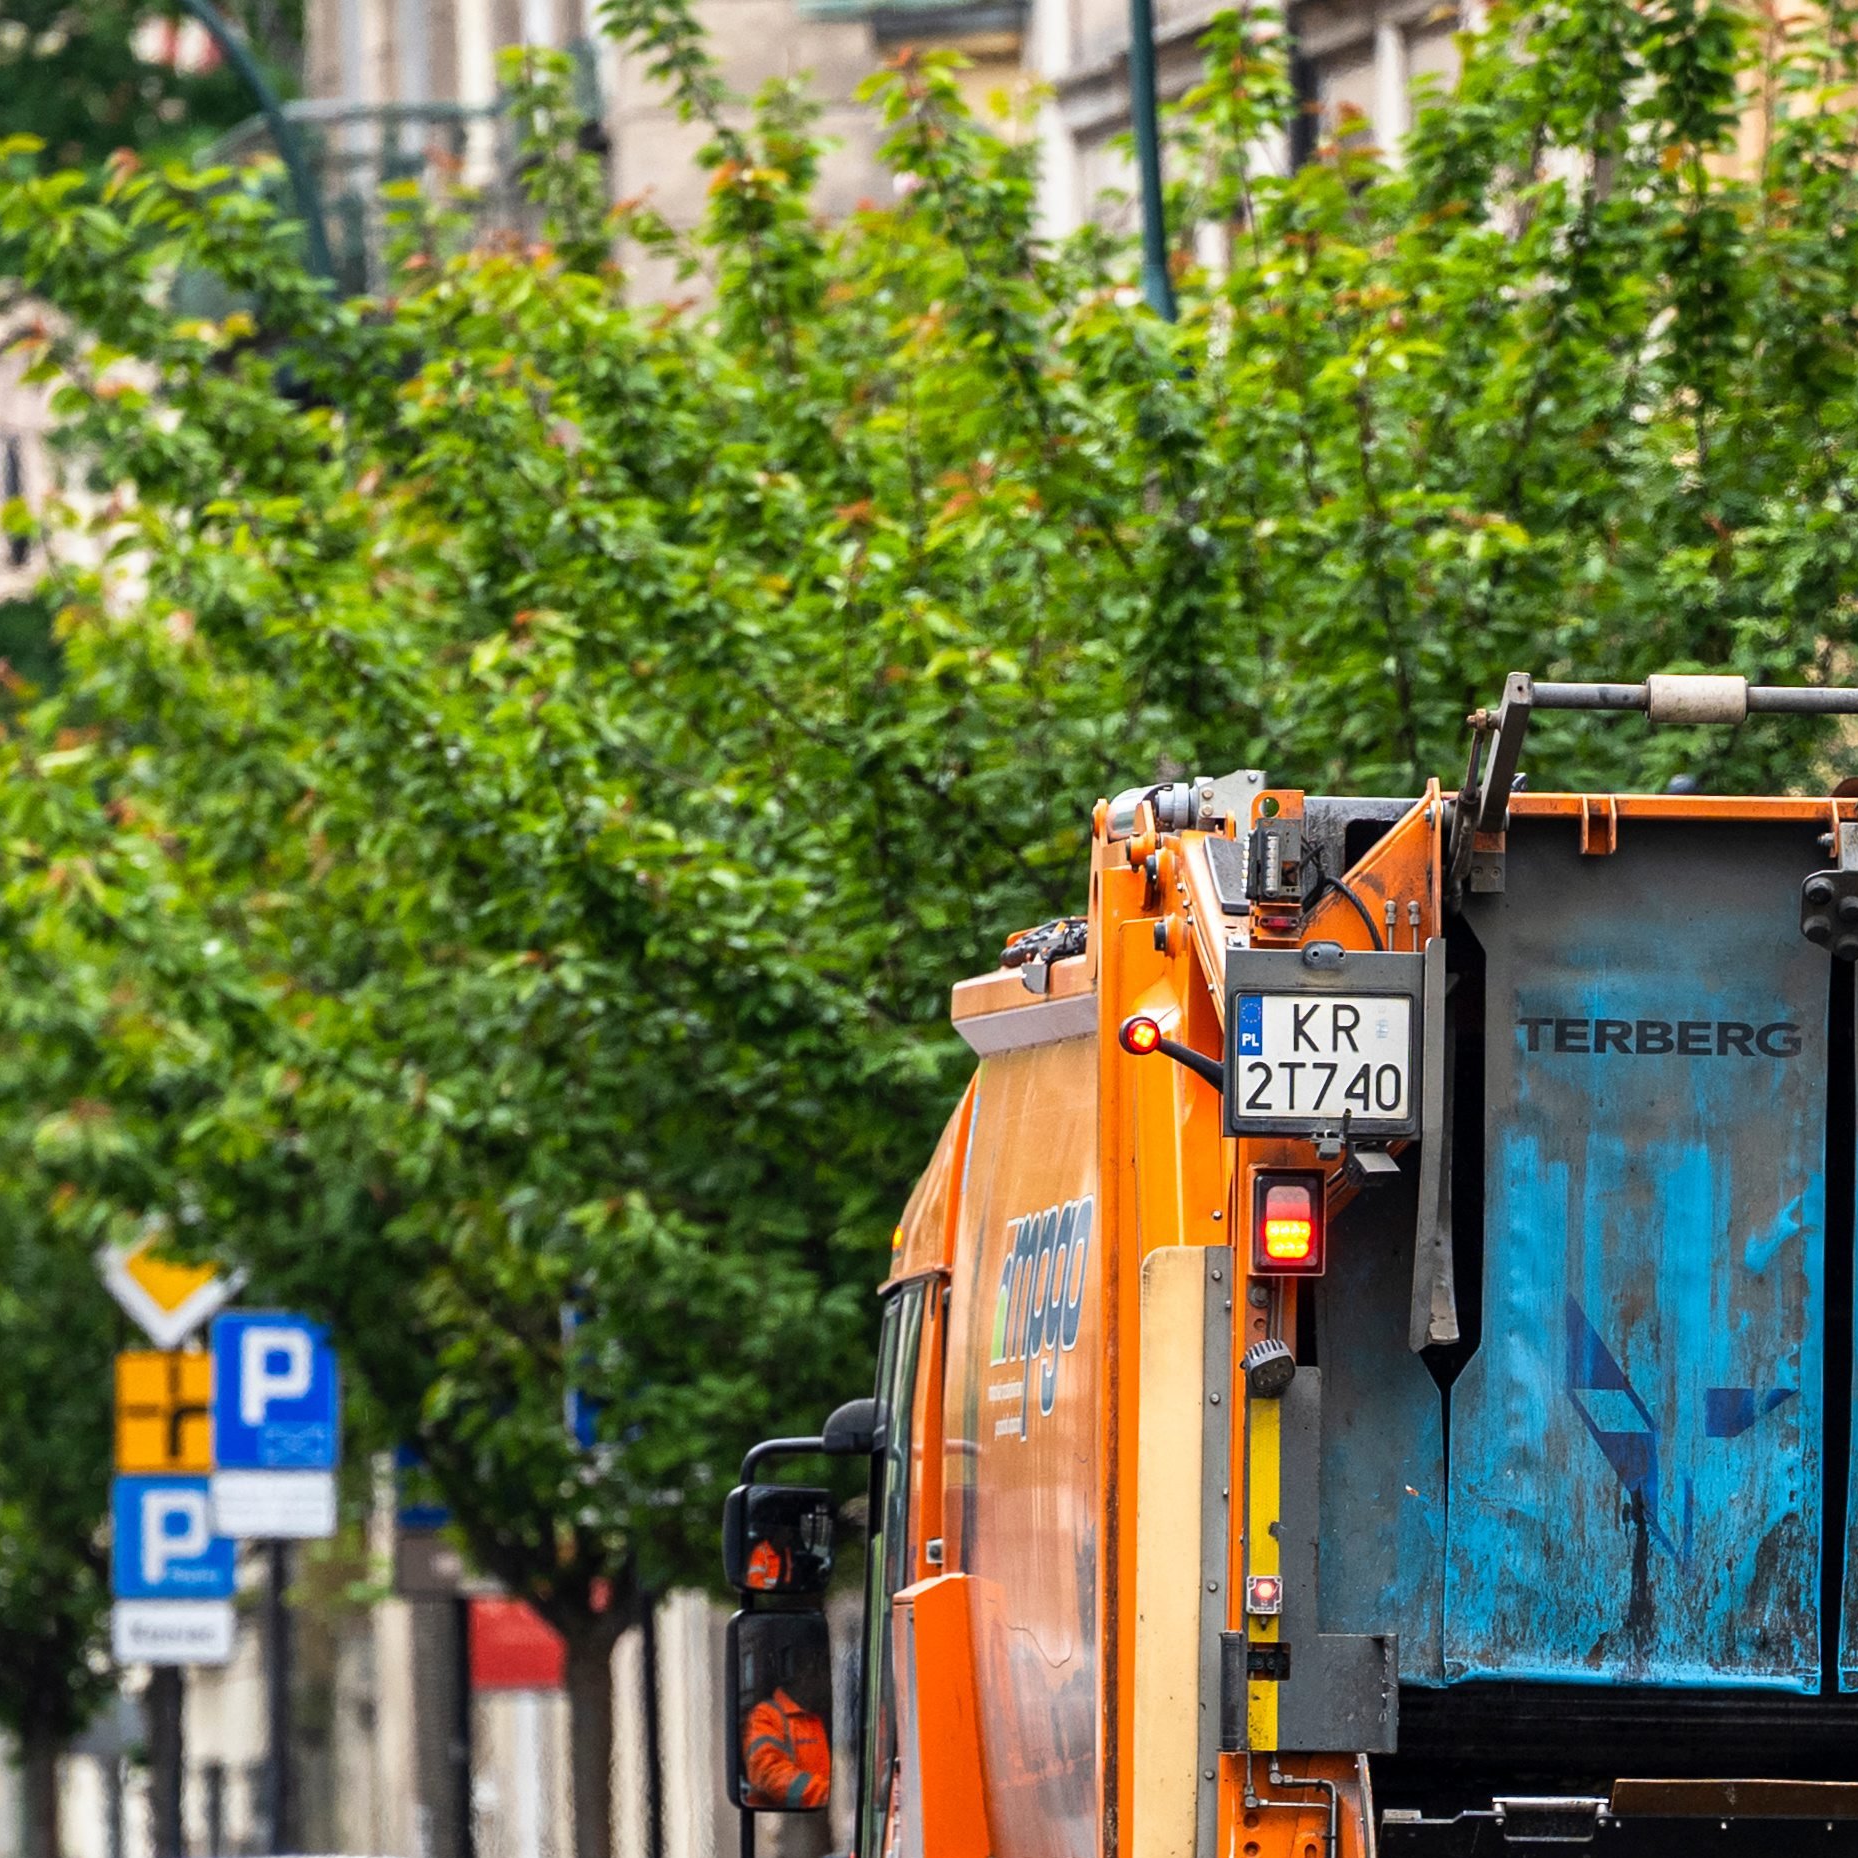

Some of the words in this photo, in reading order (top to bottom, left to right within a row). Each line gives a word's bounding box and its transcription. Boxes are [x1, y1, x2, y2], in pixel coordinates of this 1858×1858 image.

[1242, 1033, 1260, 1047] PL
[1293, 1003, 1360, 1053] KR
[1515, 1016, 1803, 1058] TERBERG
[1245, 1061, 1401, 1111] 2T740
[239, 1325, 312, 1425] P
[141, 1489, 210, 1585] P
